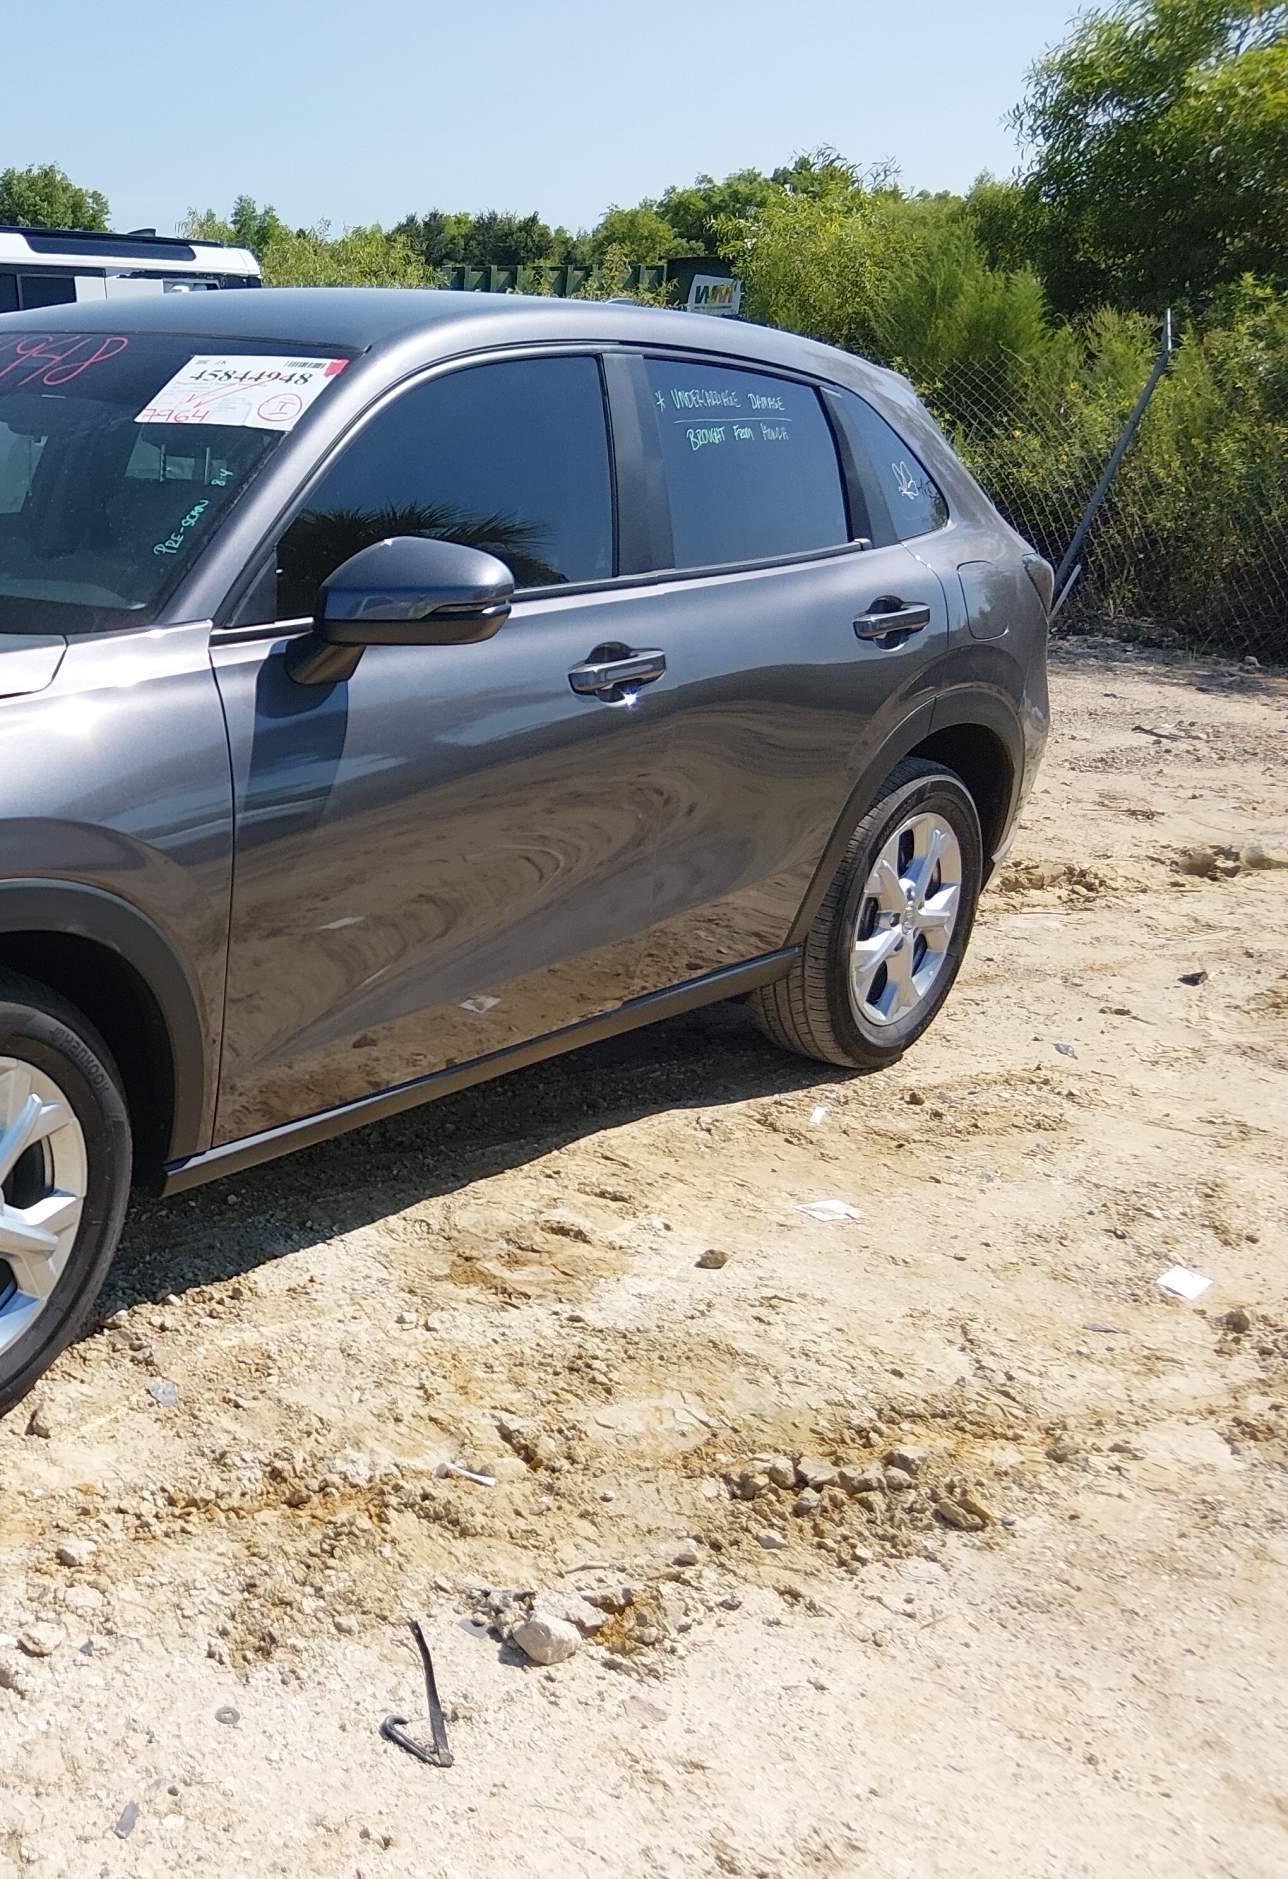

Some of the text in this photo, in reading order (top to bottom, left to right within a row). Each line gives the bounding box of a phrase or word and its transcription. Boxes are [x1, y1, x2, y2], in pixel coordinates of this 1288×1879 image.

[190, 369, 314, 386] 45844948
[686, 426, 726, 451] BROUGHT
[153, 499, 209, 555] PRE-SCAN
